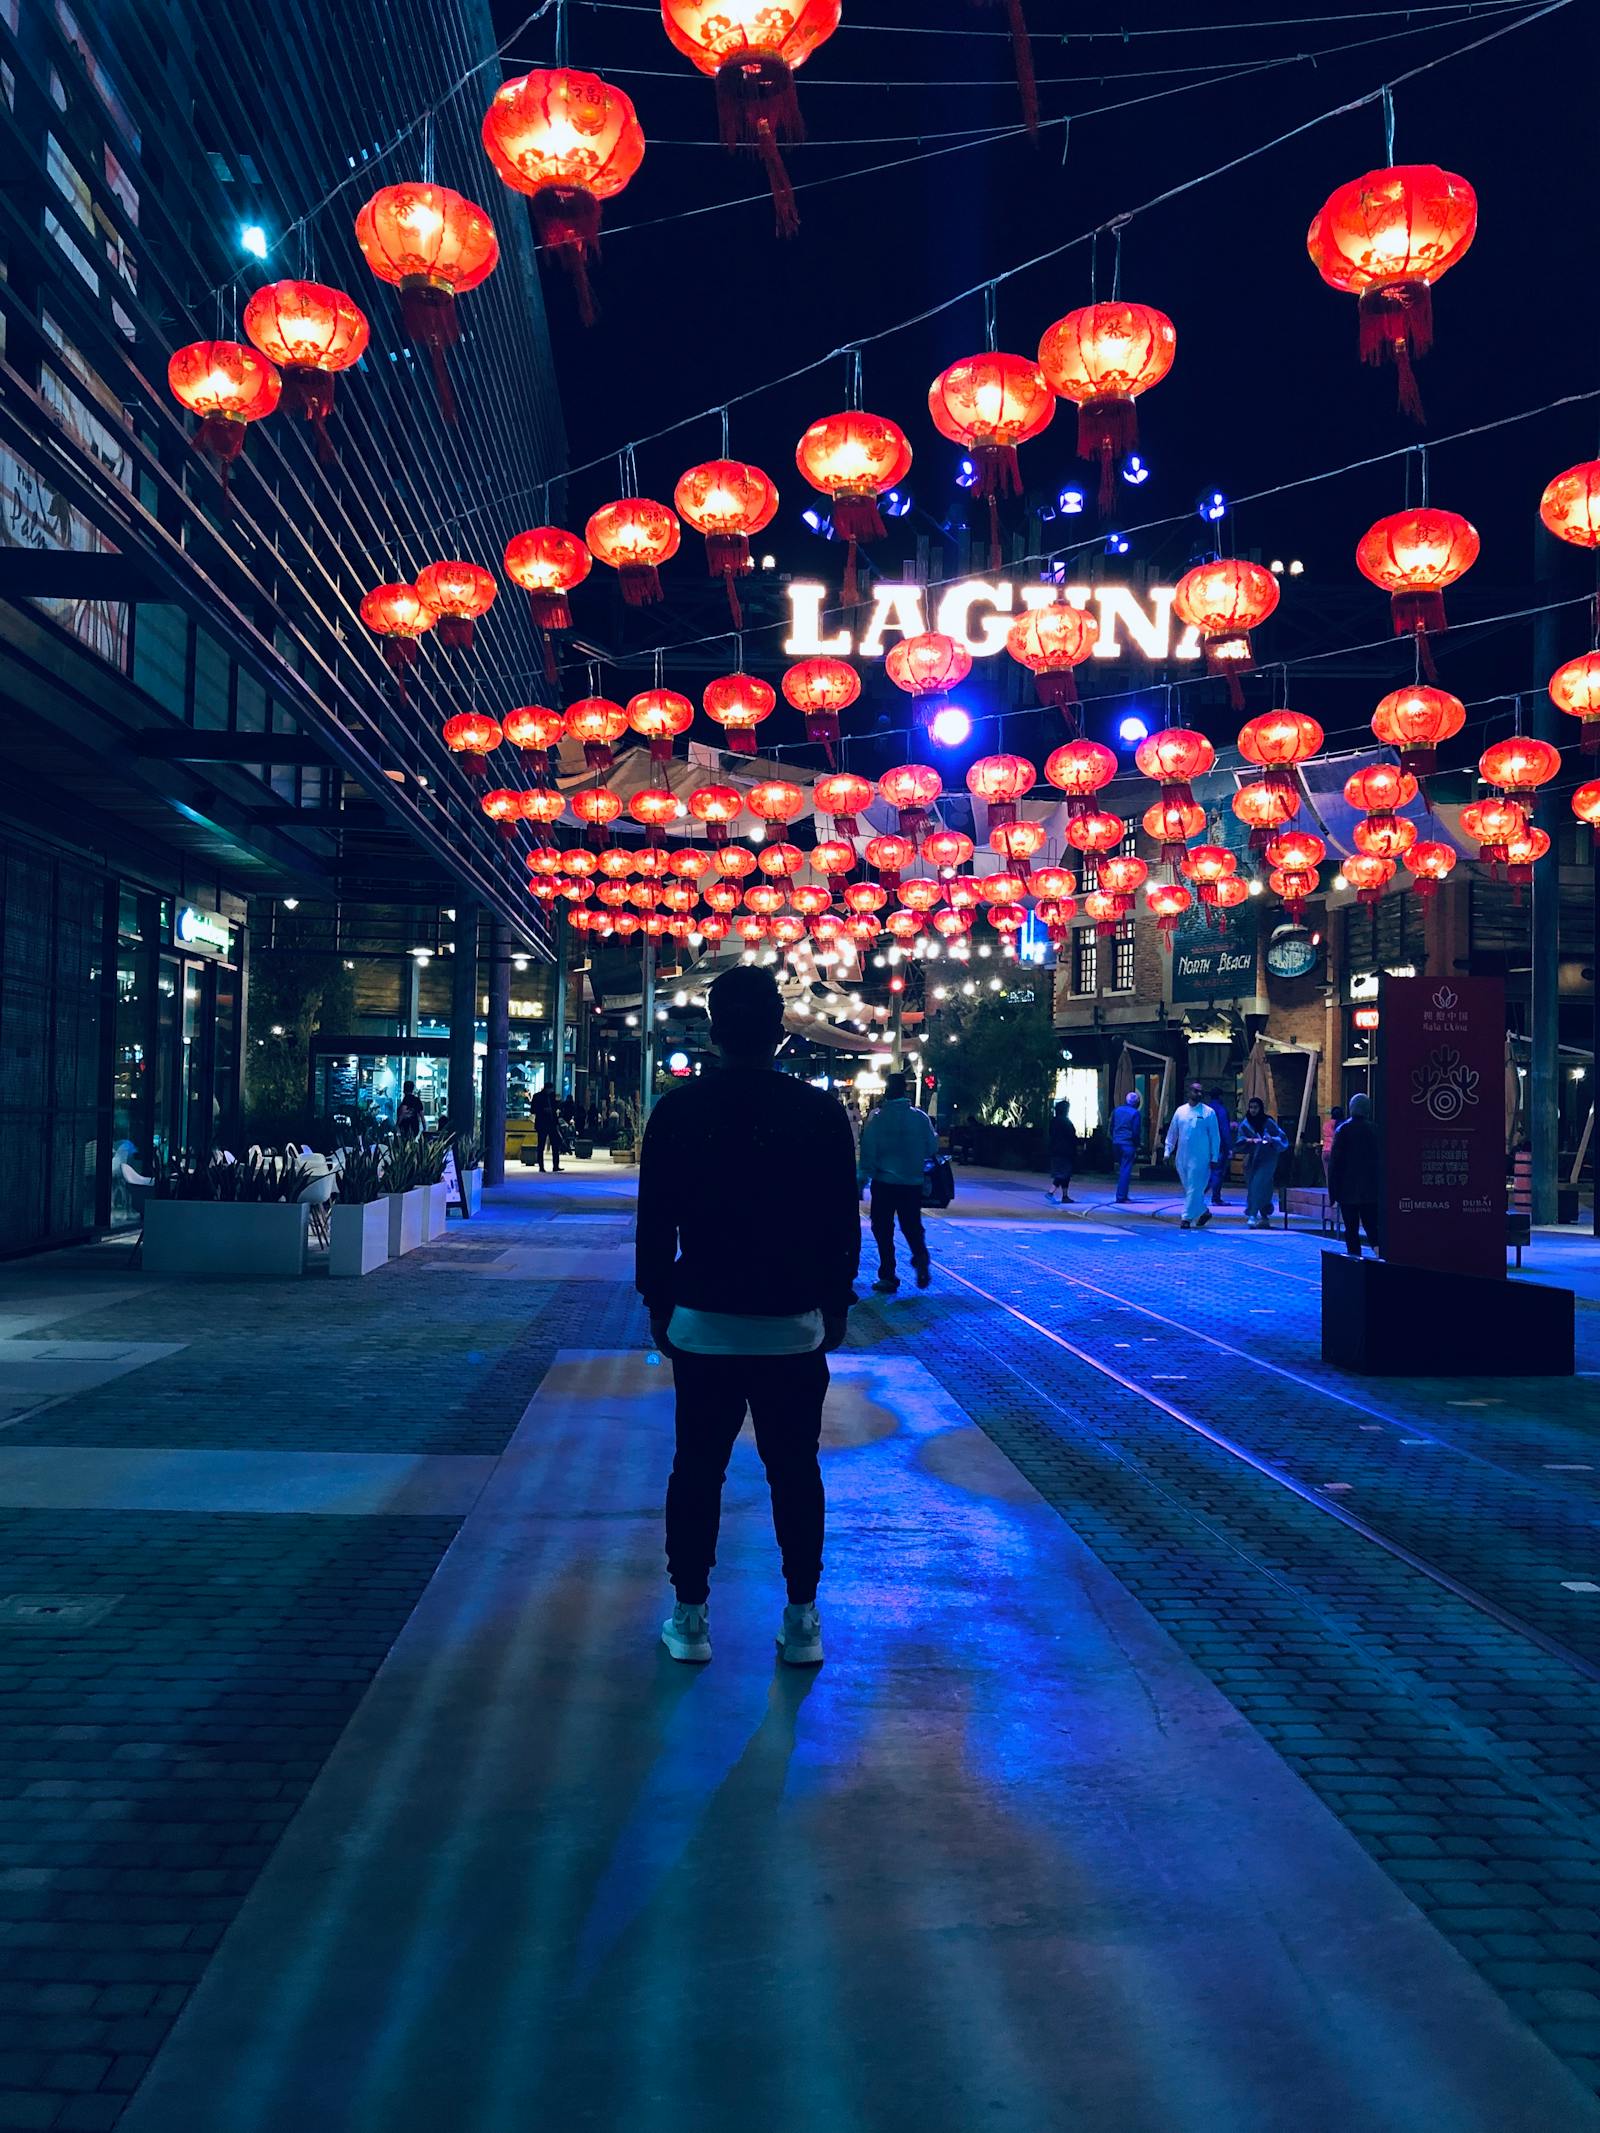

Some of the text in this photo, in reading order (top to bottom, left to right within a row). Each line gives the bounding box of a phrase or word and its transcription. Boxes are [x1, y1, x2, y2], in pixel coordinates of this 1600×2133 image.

[16, 464, 33, 495] The
[1414, 1201, 1450, 1209] MERAAS
[1463, 1197, 1492, 1207] DUBAI
